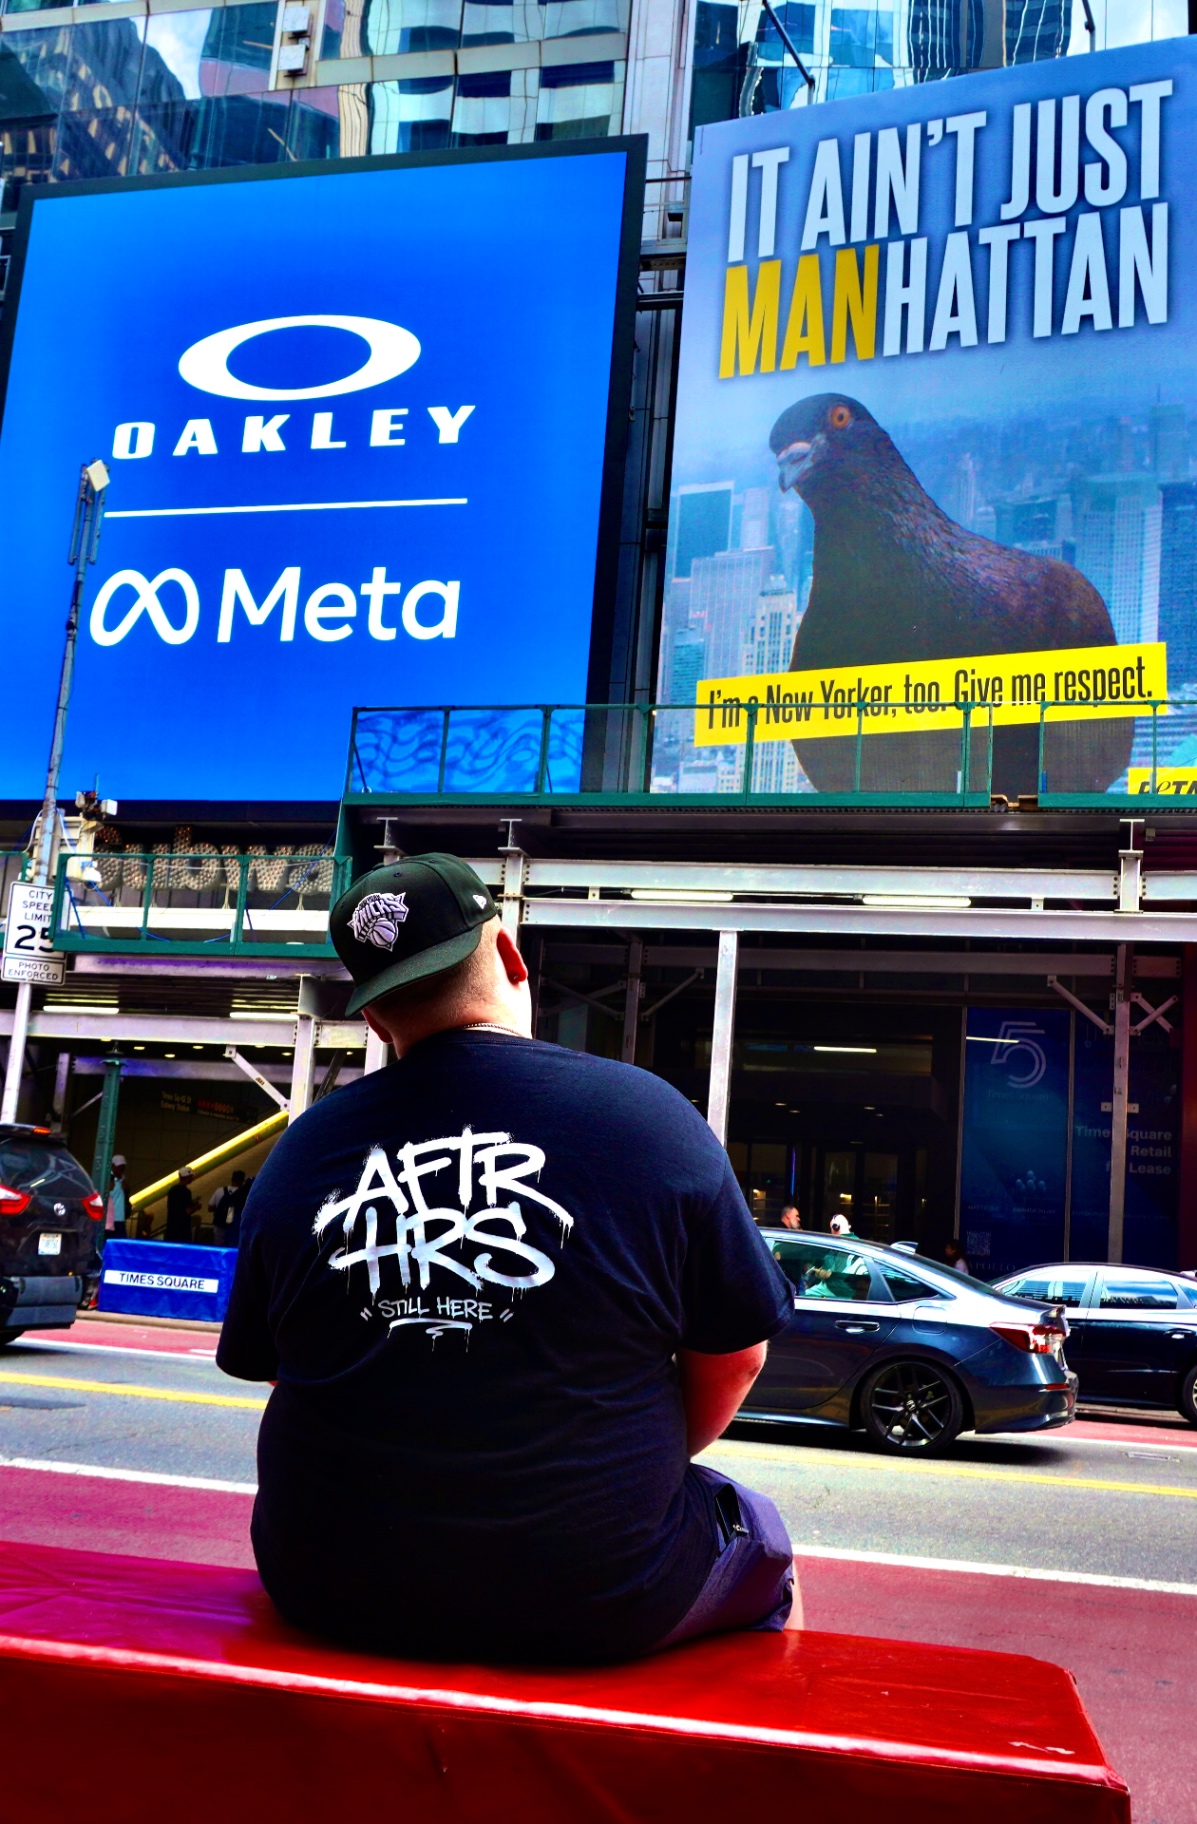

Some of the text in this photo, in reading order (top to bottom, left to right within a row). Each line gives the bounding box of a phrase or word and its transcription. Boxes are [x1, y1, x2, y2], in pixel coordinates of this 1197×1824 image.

[728, 79, 1173, 263] IT AIN'T JUST
[719, 202, 1168, 379] MANHATTAN
[112, 405, 476, 460] OAKLEY
[217, 567, 461, 642] Meta
[708, 690, 740, 729] I'm
[766, 684, 813, 724] New
[820, 677, 896, 720] Yorker,
[904, 674, 947, 714] too.
[955, 669, 1003, 710] Give
[1012, 672, 1045, 706] me
[1054, 656, 1152, 707] respect.
[22, 901, 53, 912] SPEE
[29, 890, 53, 900] CITY
[353, 893, 407, 939] KNICKS
[14, 925, 56, 953] 25
[8, 969, 59, 981] ENFORCED
[19, 962, 50, 972] PHOTO
[1075, 1126, 1112, 1138] Time
[1131, 1145, 1172, 1157] Retail
[312, 1125, 574, 1234] AFTR
[1129, 1162, 1171, 1175] Lease
[328, 1202, 556, 1294] HRS
[119, 1272, 205, 1290] TIMES SQUARE
